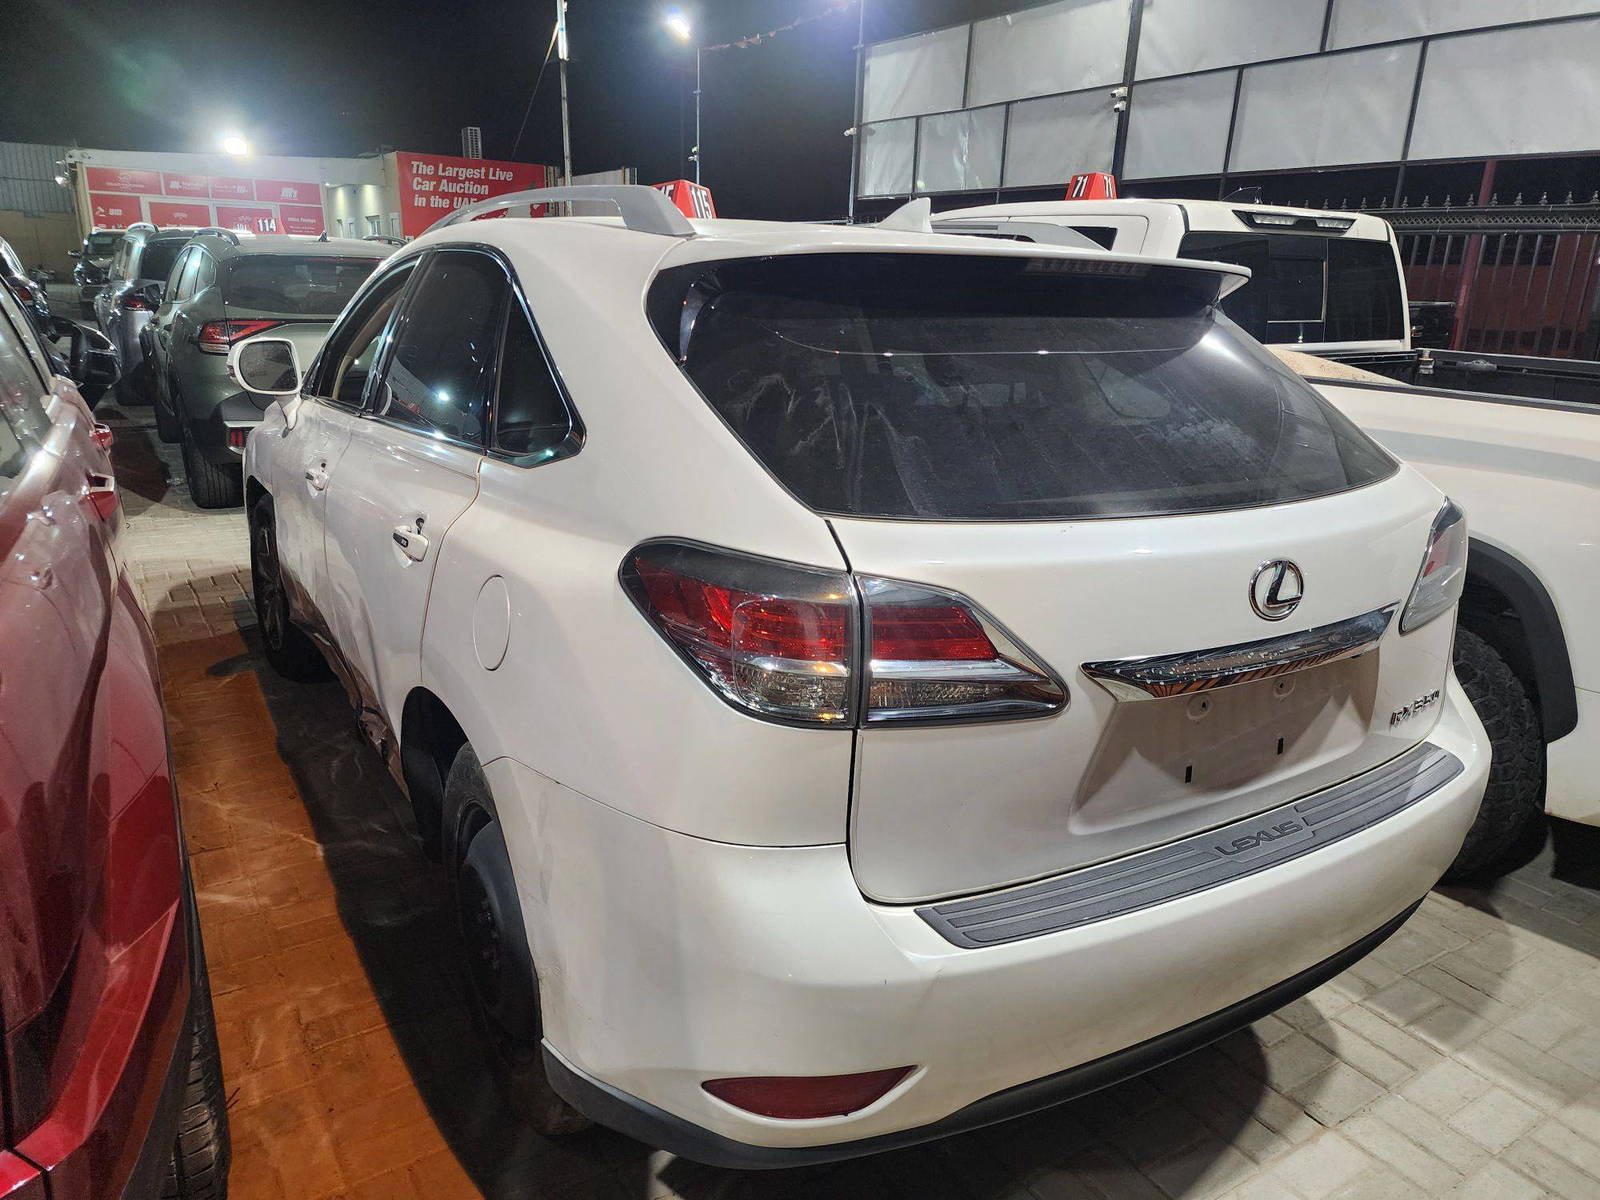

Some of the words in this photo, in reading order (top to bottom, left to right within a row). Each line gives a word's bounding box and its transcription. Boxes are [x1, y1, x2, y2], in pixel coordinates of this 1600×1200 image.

[411, 161, 434, 176] The
[438, 163, 486, 180] Largest
[488, 167, 513, 181] Live
[412, 177, 436, 191] Car
[438, 178, 489, 195] Auction
[1072, 176, 1089, 198] 71
[413, 194, 427, 207] in
[430, 195, 450, 208] the
[691, 186, 712, 221] 115
[257, 217, 277, 232] 114
[1214, 821, 1303, 856] LEXUS
